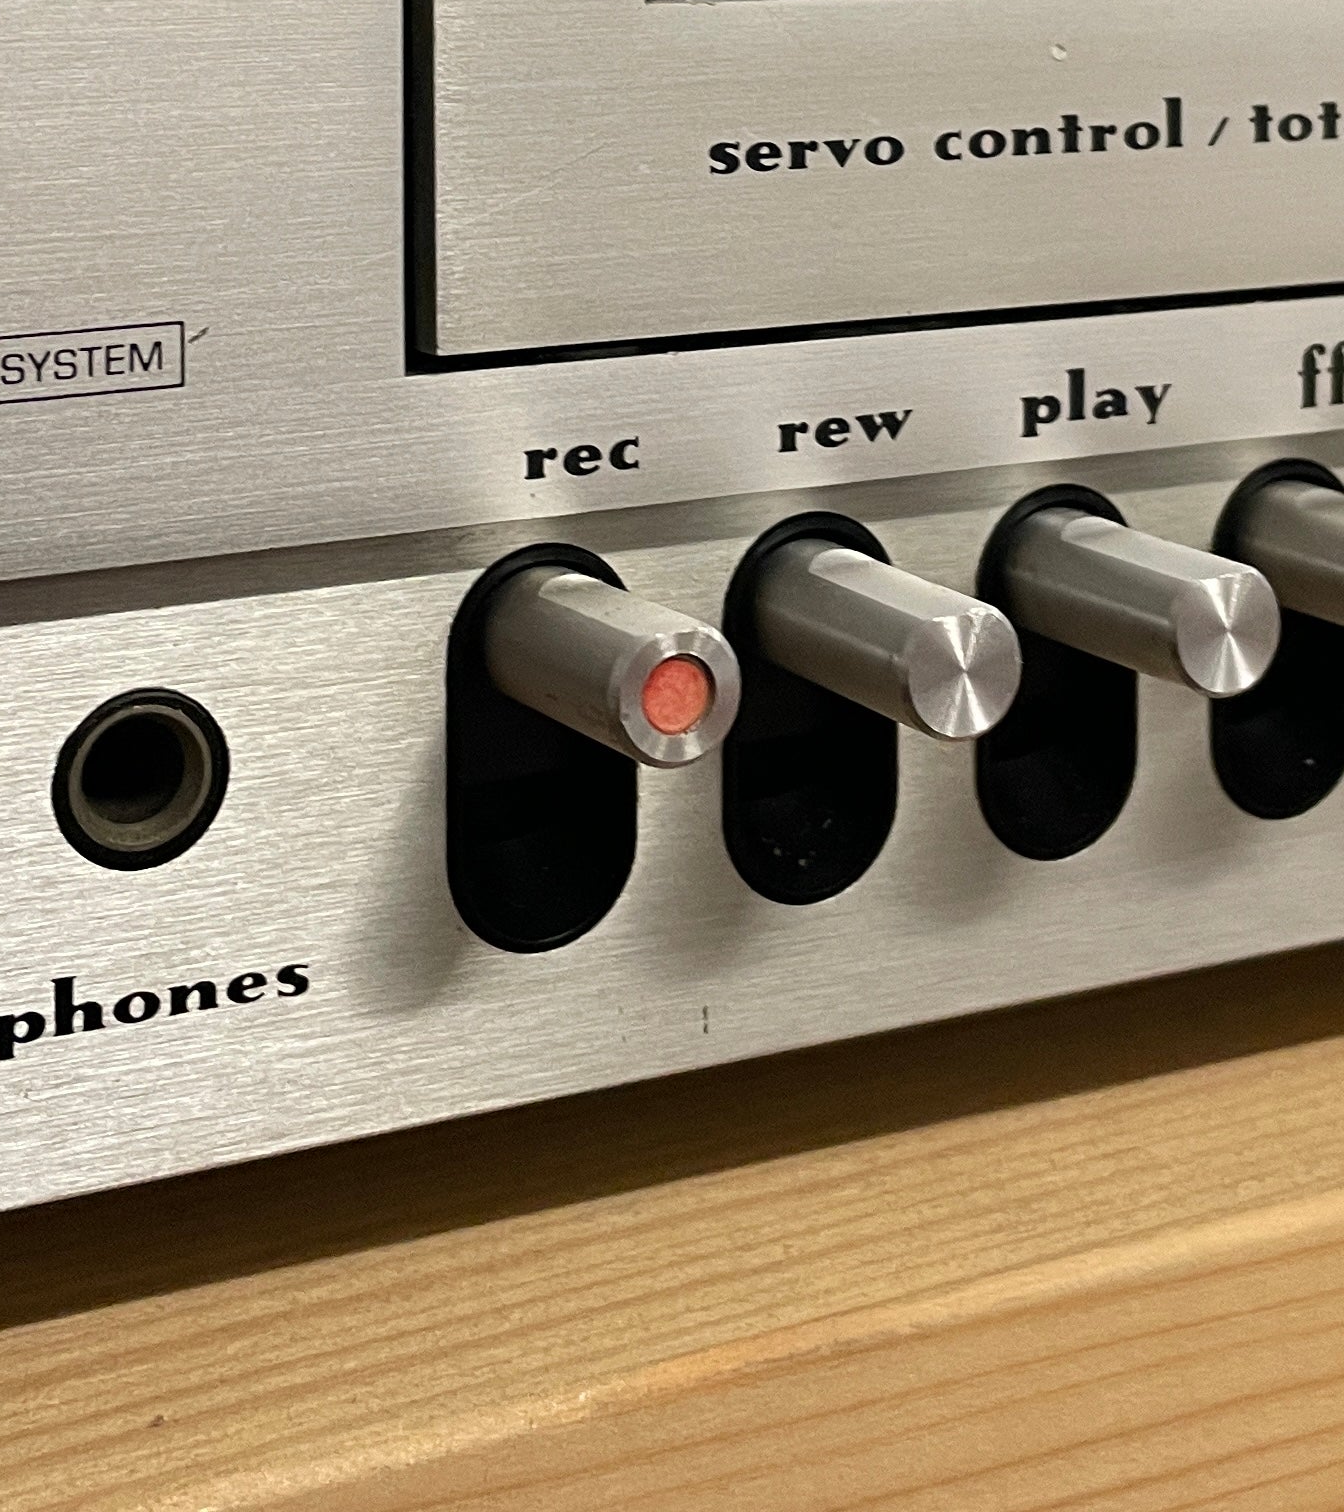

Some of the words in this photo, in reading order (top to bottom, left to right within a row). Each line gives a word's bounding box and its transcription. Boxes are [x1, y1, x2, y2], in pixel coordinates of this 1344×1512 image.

[708, 132, 907, 175] servo
[932, 96, 1186, 163] control
[0, 340, 164, 386] SYSTEM
[1019, 366, 1172, 438] play
[776, 408, 913, 454] rew
[524, 436, 641, 481] rec
